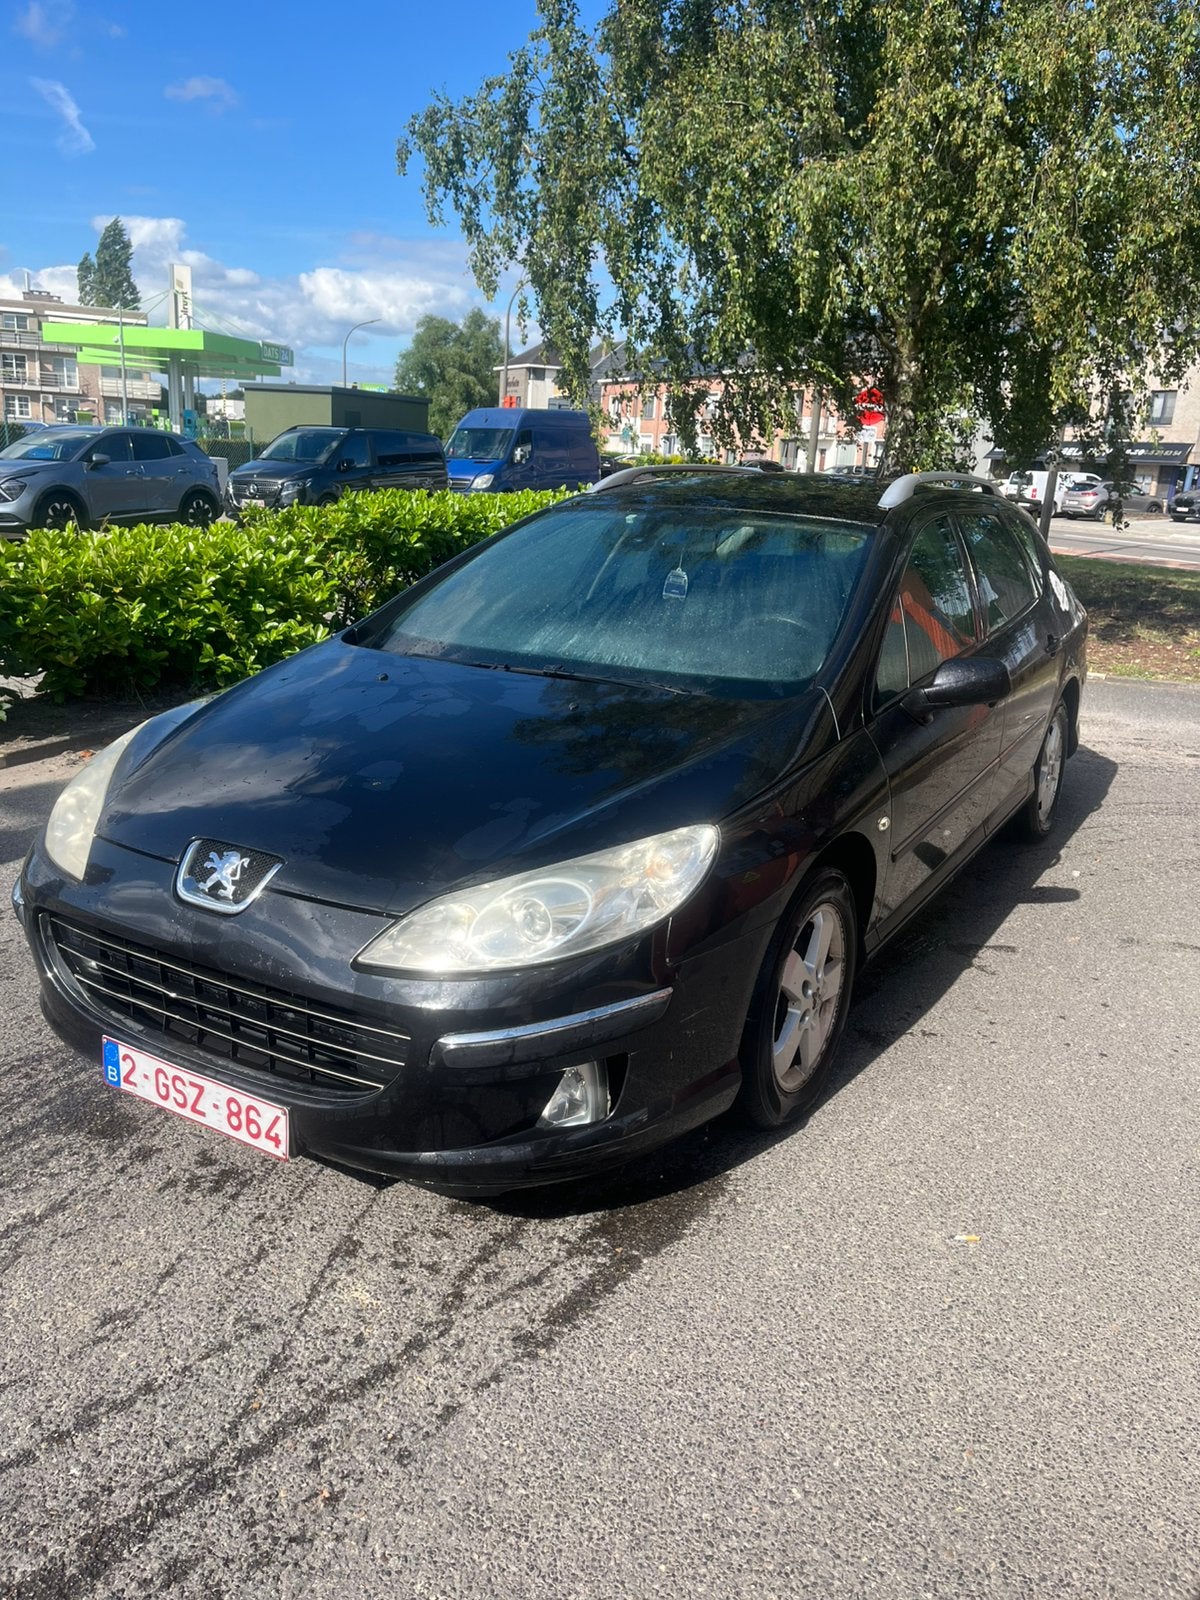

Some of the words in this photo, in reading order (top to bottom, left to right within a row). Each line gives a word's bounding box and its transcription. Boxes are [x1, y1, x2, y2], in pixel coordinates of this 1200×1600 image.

[263, 345, 279, 360] DATS
[107, 1065, 118, 1083] B
[121, 1053, 282, 1149] 2-GSZ-864
